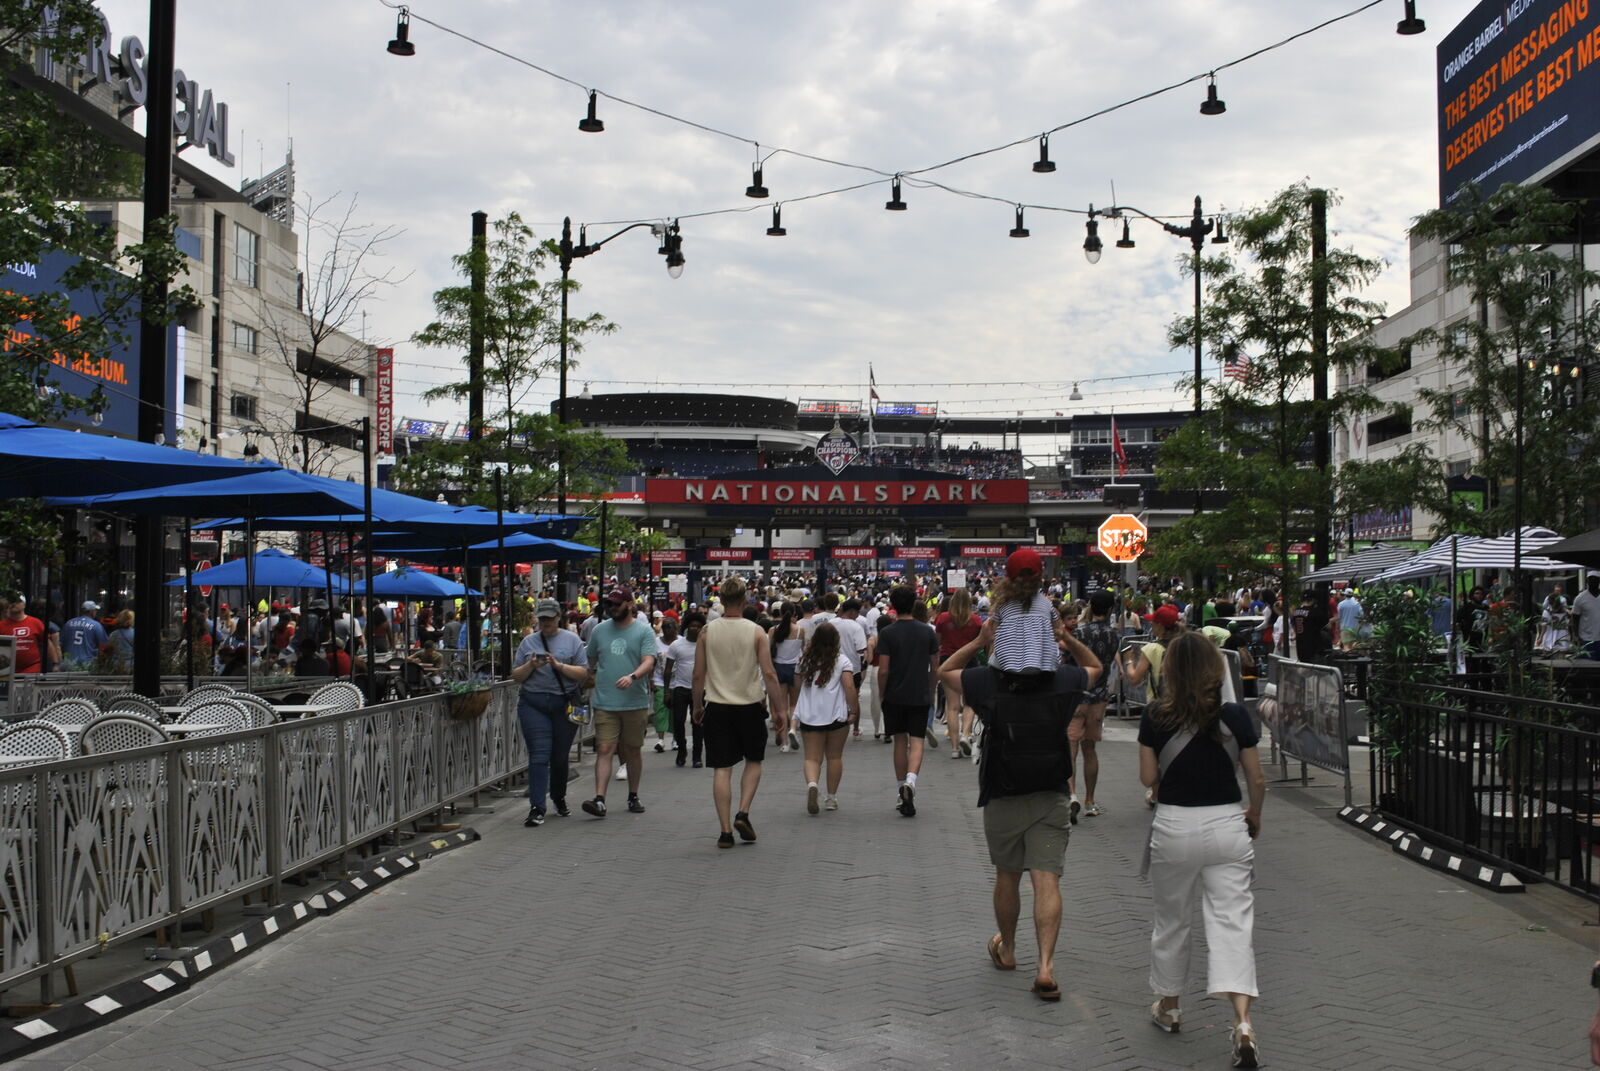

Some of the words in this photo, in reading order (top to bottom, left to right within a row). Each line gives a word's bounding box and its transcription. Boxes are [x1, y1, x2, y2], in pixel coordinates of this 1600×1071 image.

[1443, 42, 1475, 84] ORANGE
[1474, 15, 1504, 56] BARREL
[1445, 91, 1467, 130] THE
[1469, 63, 1499, 112] BEST
[1501, 0, 1589, 85] MESSAGING
[119, 35, 235, 168] SCIAL
[1446, 103, 1505, 171] DESERVES
[1506, 80, 1534, 123] THE
[1537, 46, 1575, 102] BEST
[379, 369, 391, 404] TEAM
[379, 407, 391, 448] STORE
[817, 447, 857, 455] CHAMPIONS
[685, 483, 888, 502] NATIONALS
[901, 483, 988, 502] PARK
[73, 630, 85, 645] 5
